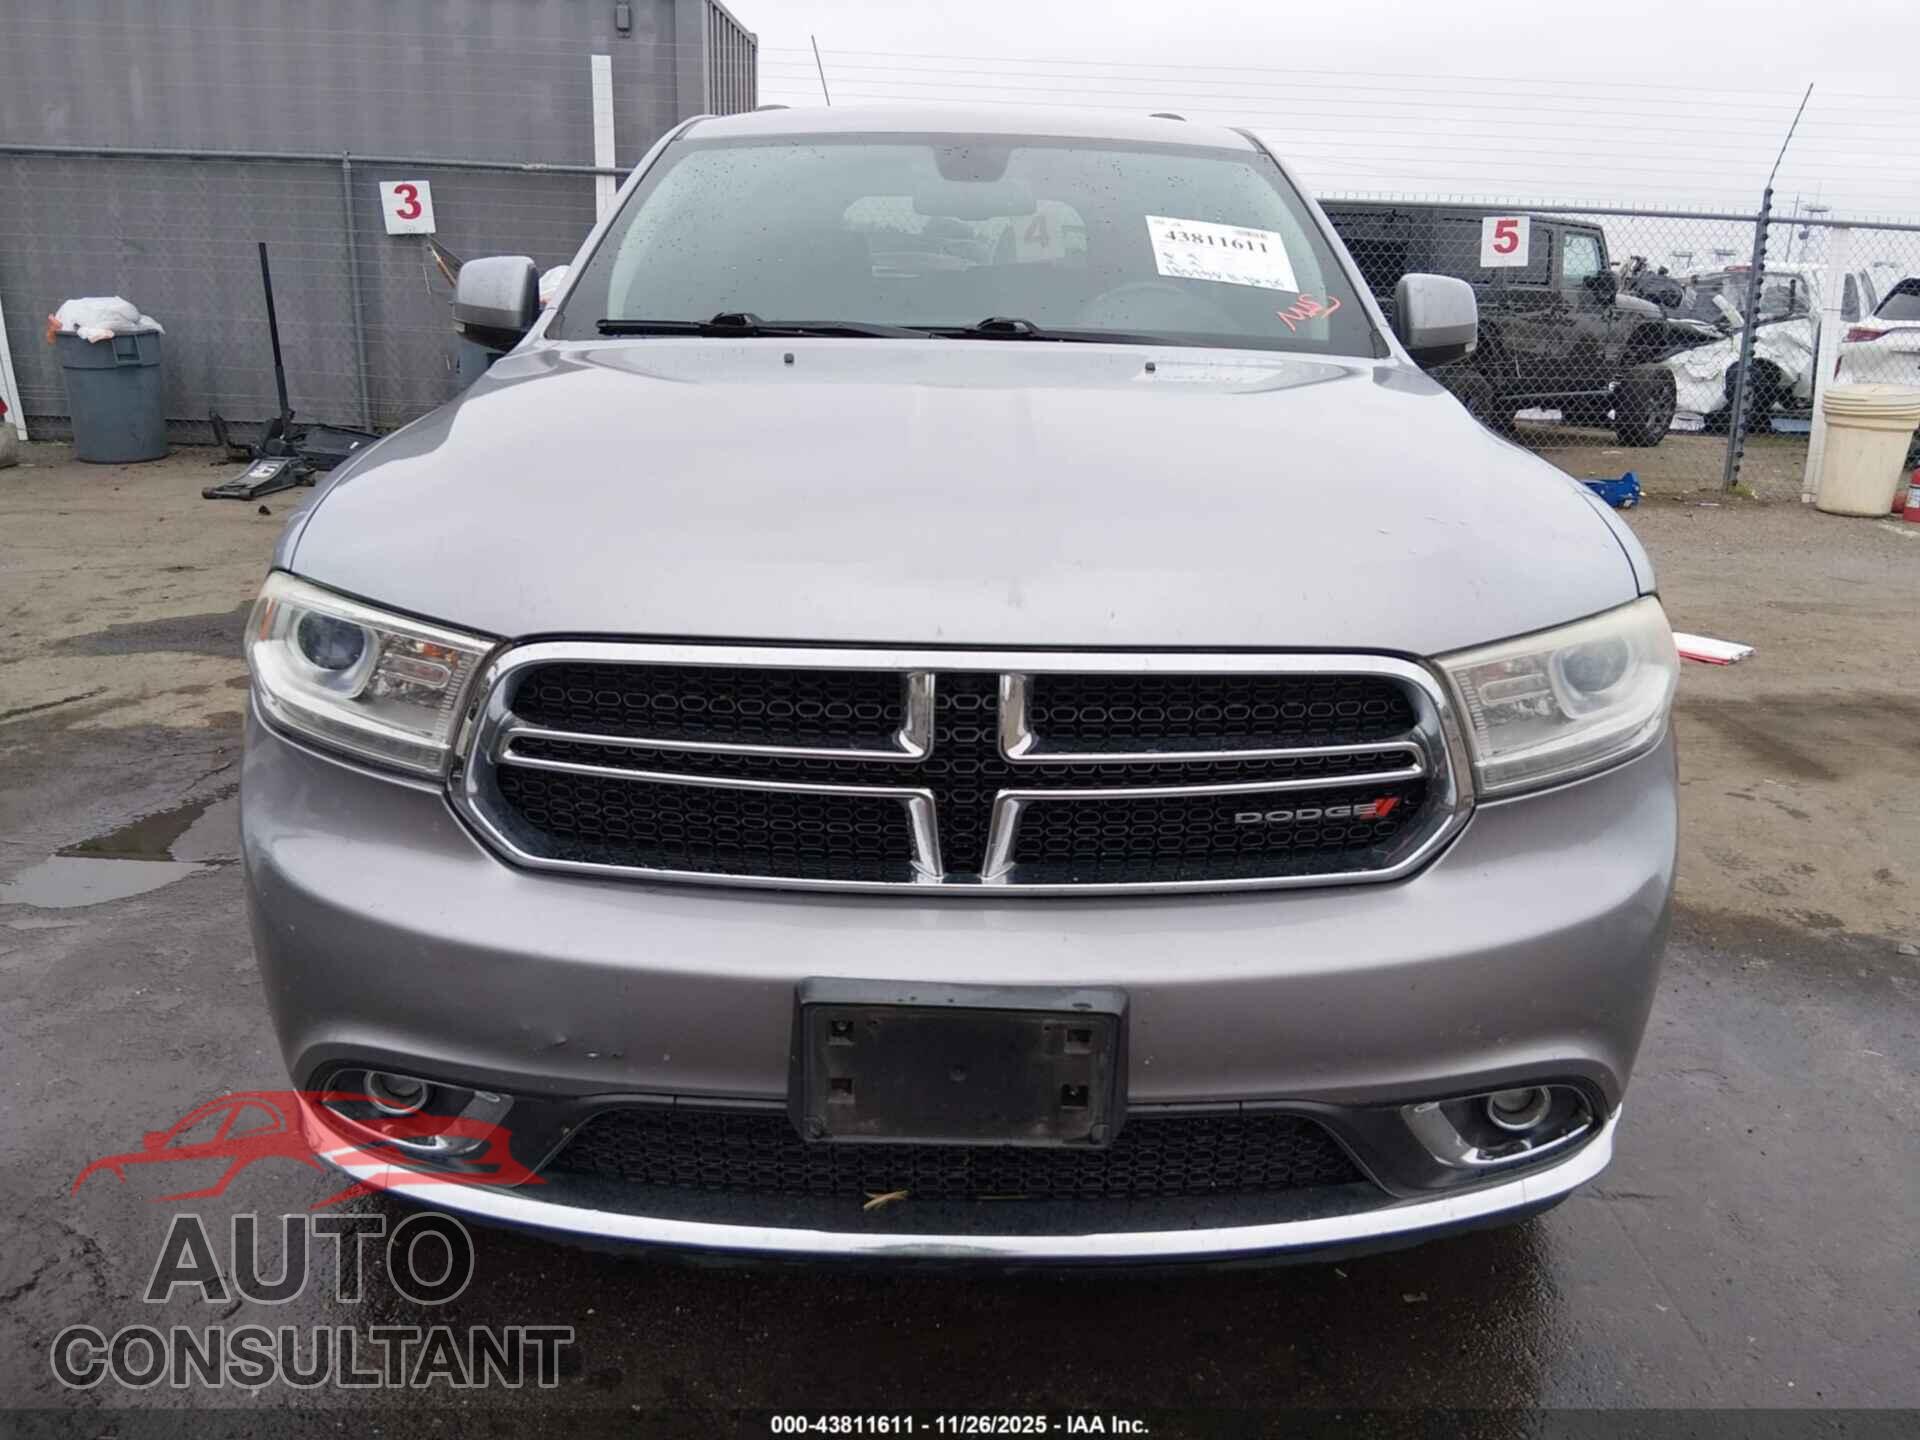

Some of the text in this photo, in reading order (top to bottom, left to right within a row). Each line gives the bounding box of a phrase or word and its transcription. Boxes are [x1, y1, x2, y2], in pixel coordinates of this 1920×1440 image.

[394, 184, 422, 220] 3
[1024, 216, 1050, 249] 4
[1164, 230, 1269, 254] 43811611
[1493, 220, 1519, 254] 5
[1234, 802, 1377, 824] DODGE
